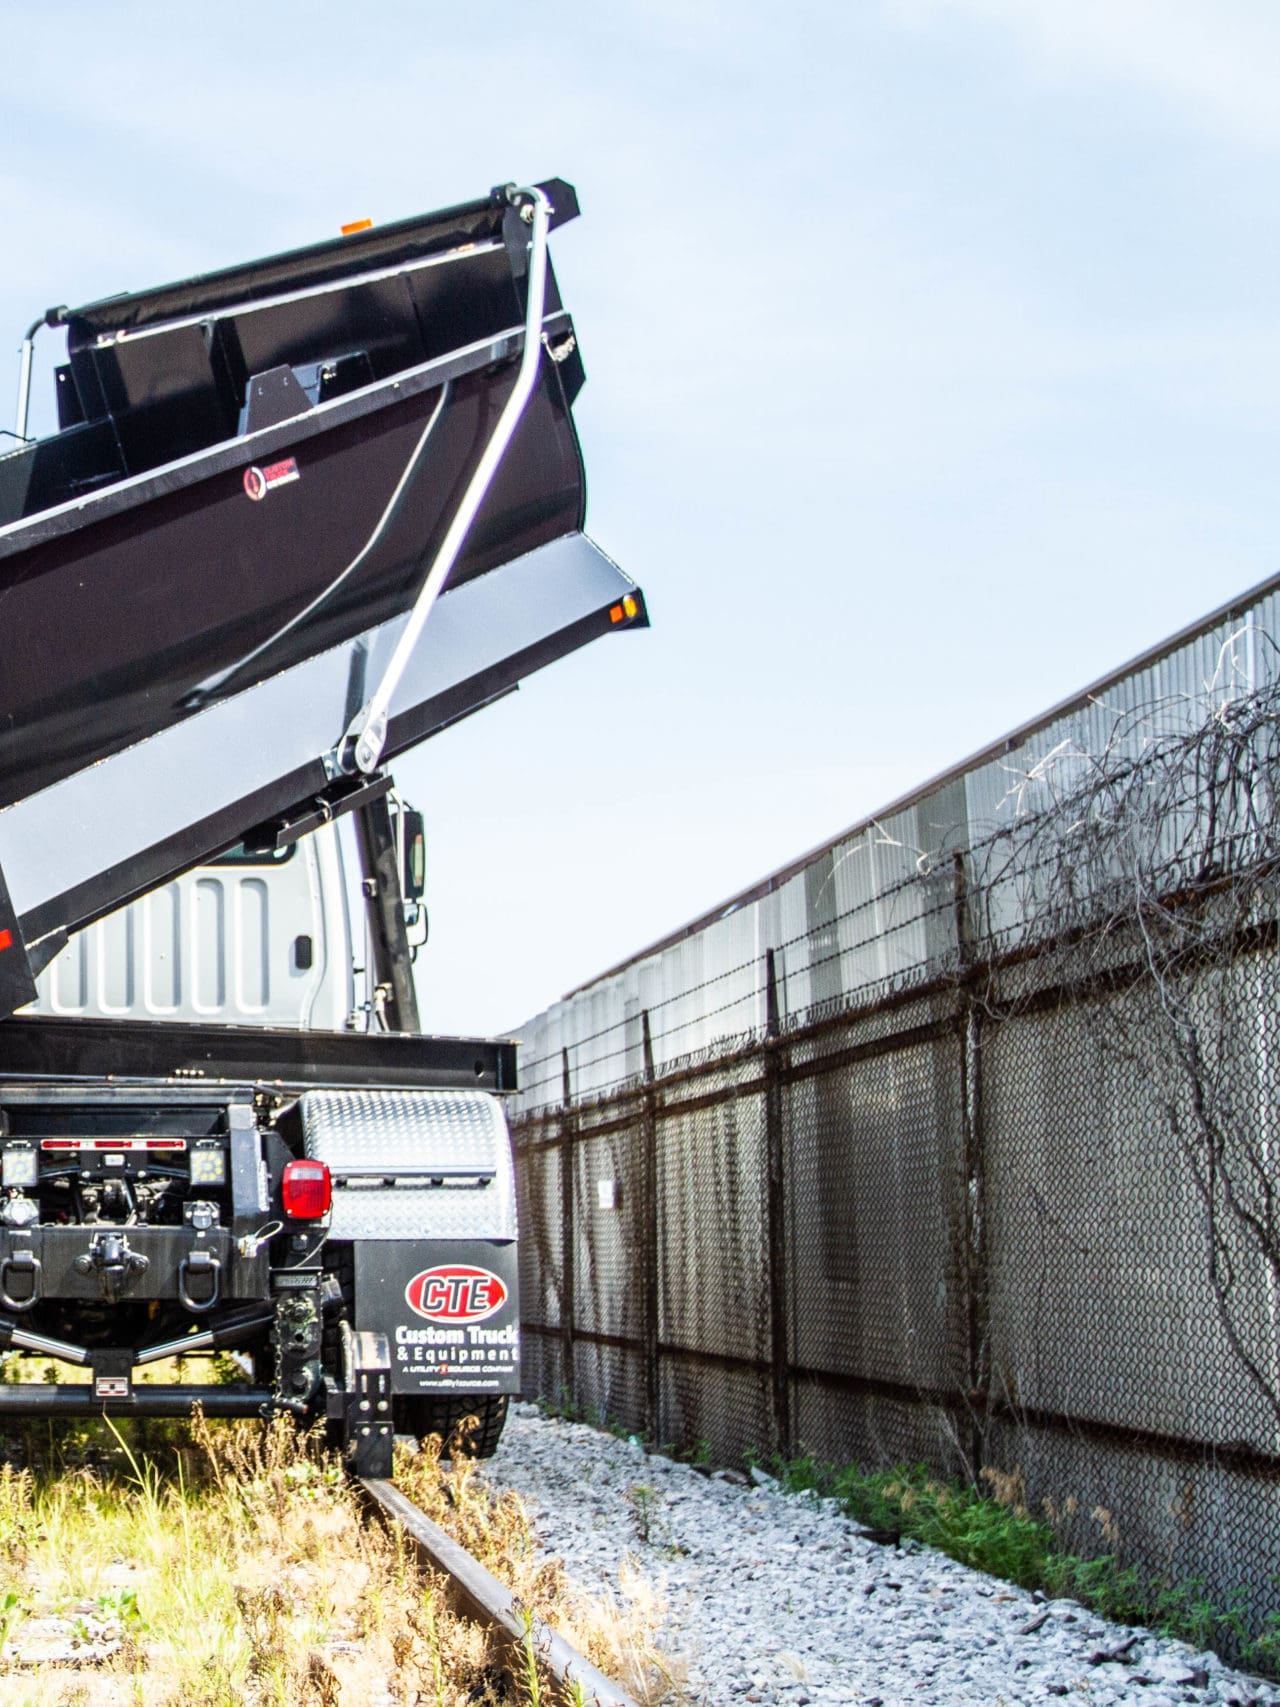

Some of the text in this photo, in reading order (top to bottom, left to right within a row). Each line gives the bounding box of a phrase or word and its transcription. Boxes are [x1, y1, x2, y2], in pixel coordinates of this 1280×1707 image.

[420, 1276, 491, 1312] CTE
[395, 1325, 519, 1344] Custom Truck
[397, 1346, 519, 1363] & Equipment
